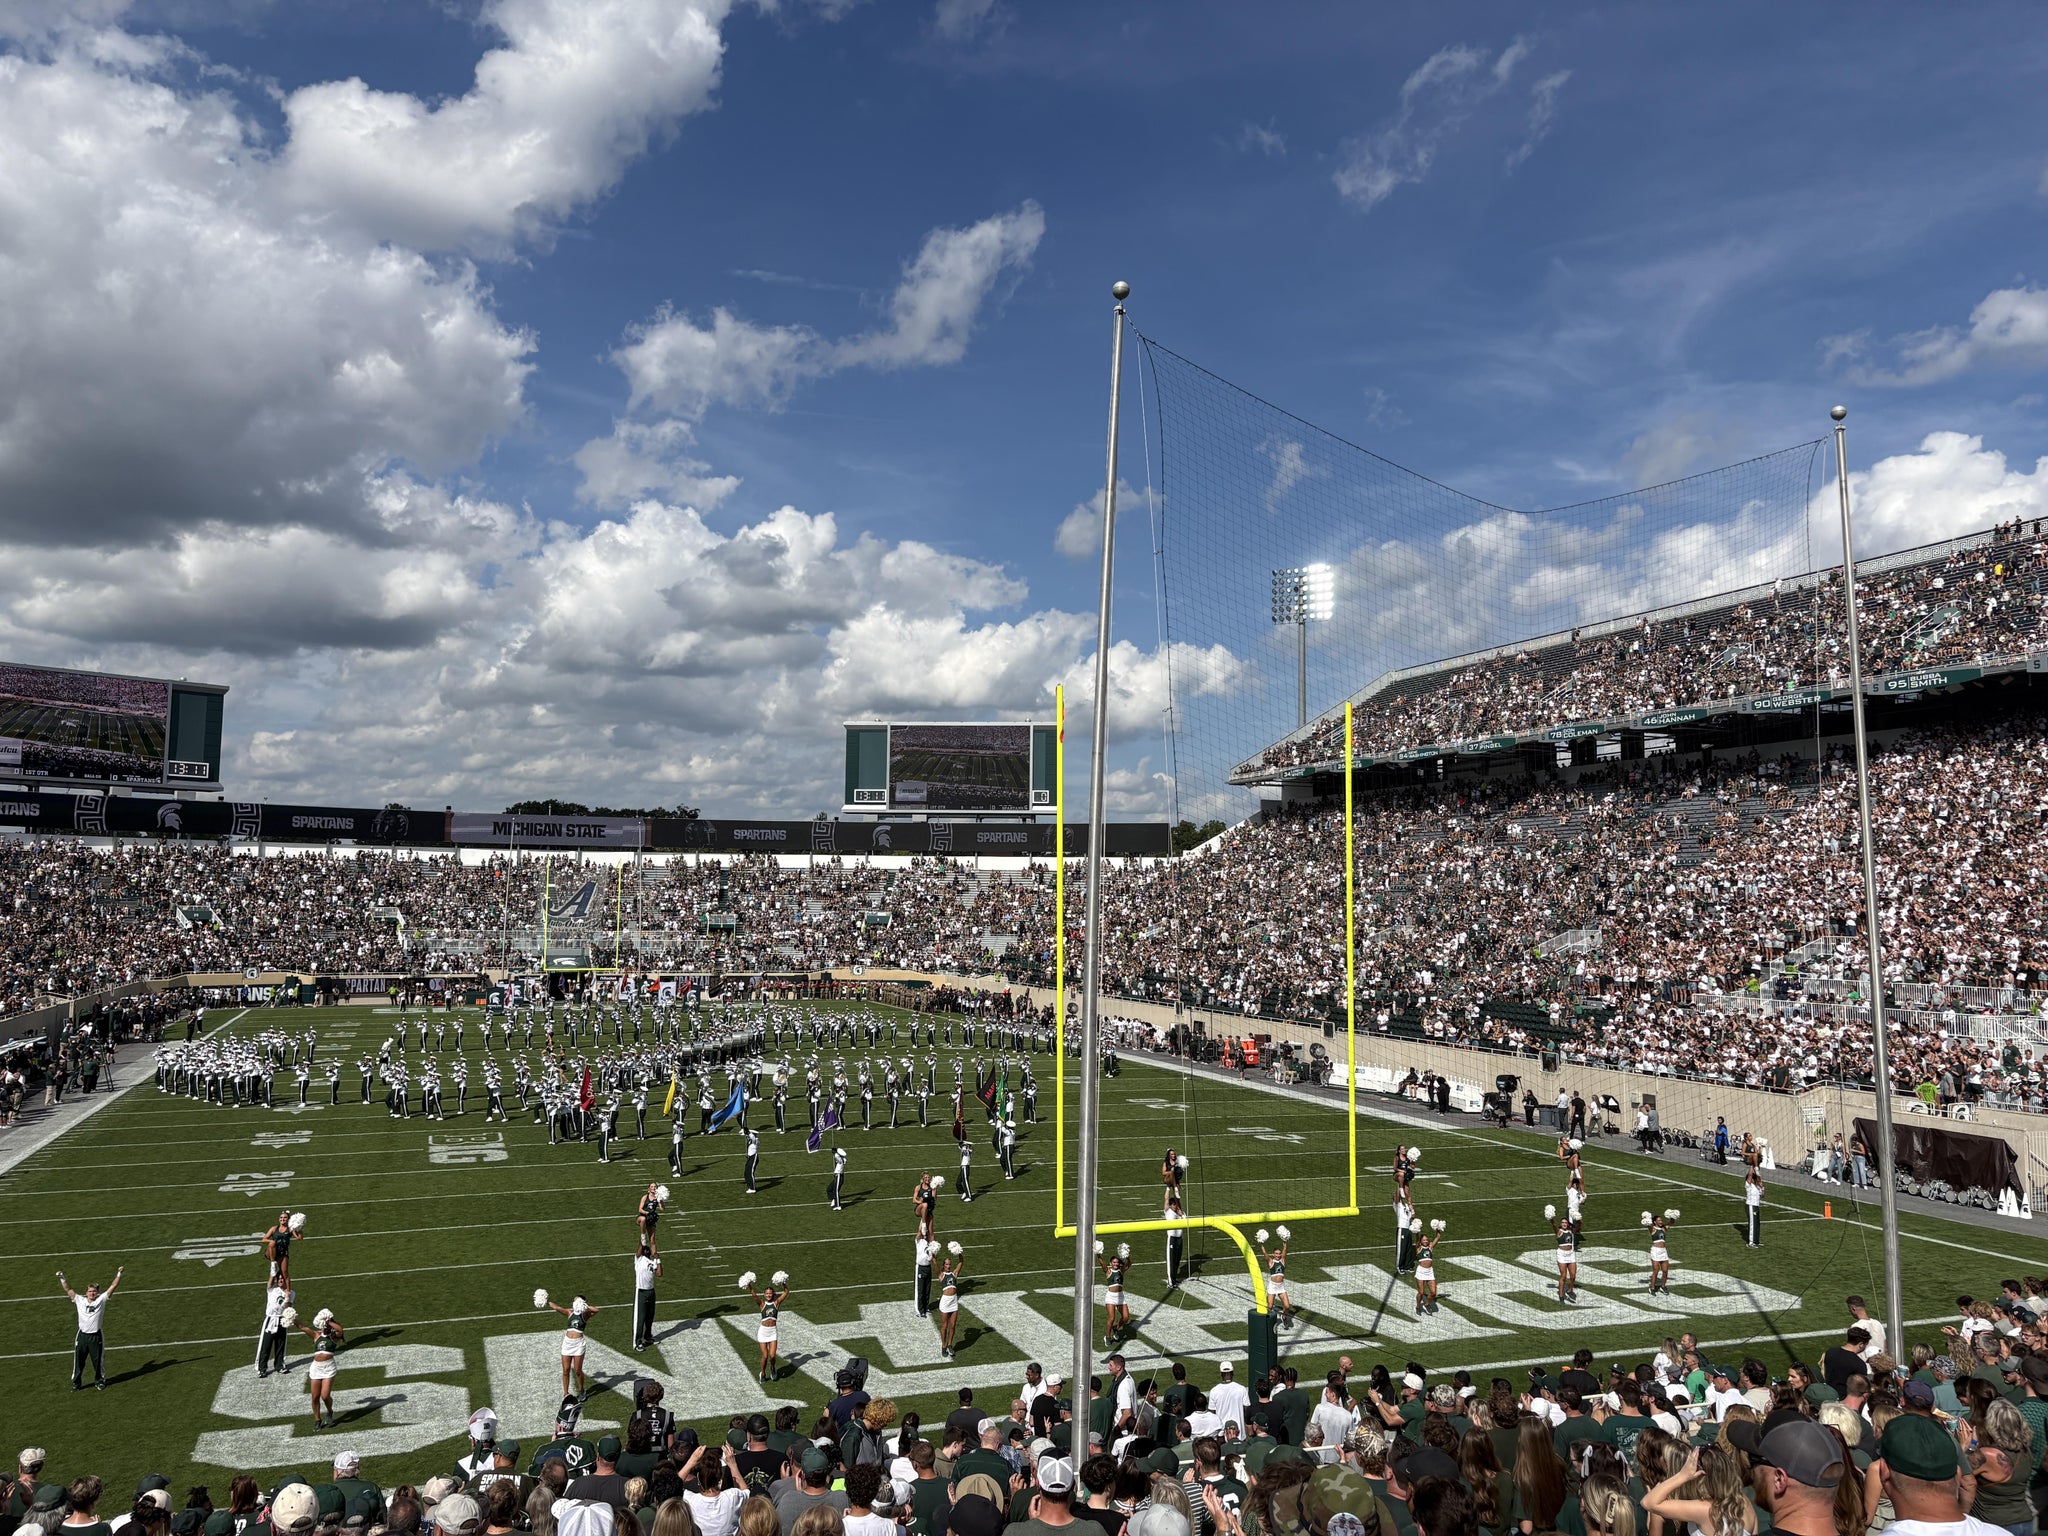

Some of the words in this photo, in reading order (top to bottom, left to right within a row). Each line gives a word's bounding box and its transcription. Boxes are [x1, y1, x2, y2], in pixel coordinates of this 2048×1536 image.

[1910, 673, 1941, 682] BUBBA
[1910, 677, 1947, 689] SMITH
[1888, 680, 1907, 689] 95
[1772, 693, 1804, 702] GEORGE
[1773, 696, 1821, 708] WEBSTER
[1754, 701, 1770, 709] 90
[1643, 716, 1658, 725] 46
[1658, 714, 1696, 725] HANNAH
[1659, 712, 1677, 720] JOHN
[1550, 731, 1562, 739] 78
[1563, 729, 1598, 739] COLEMAN
[1479, 743, 1502, 751] PINGEL
[174, 764, 206, 775] 13:11
[292, 815, 354, 830] SPARTANS
[492, 821, 562, 837] MICHIGAN
[566, 824, 607, 838] STATE
[733, 828, 787, 841] SPARTANS
[976, 831, 1028, 843] SPARTANS
[346, 978, 386, 993] SPARTAN
[218, 1170, 296, 1192] 20
